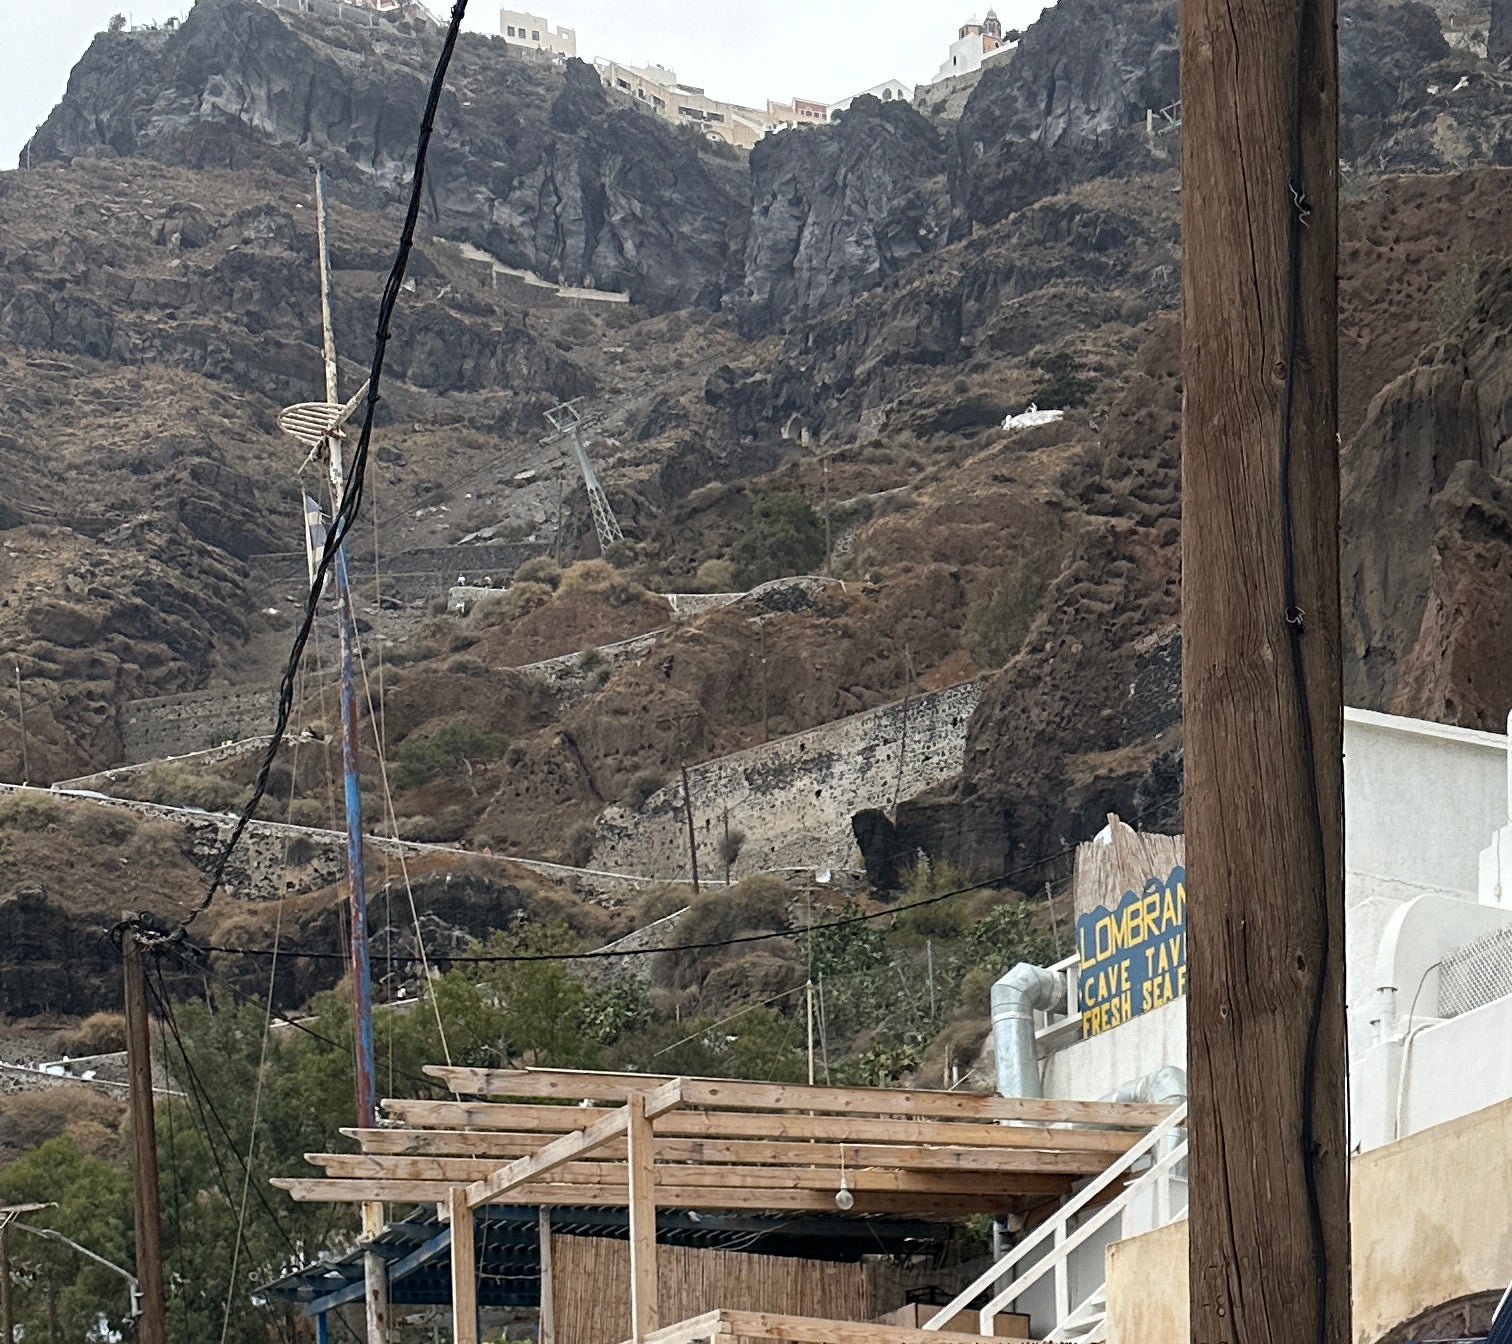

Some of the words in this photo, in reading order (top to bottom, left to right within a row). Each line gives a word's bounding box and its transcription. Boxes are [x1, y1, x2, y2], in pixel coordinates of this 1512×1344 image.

[1085, 958, 1131, 1007] CAVE
[1145, 931, 1186, 978] TAV
[1083, 990, 1131, 1040] FRESH
